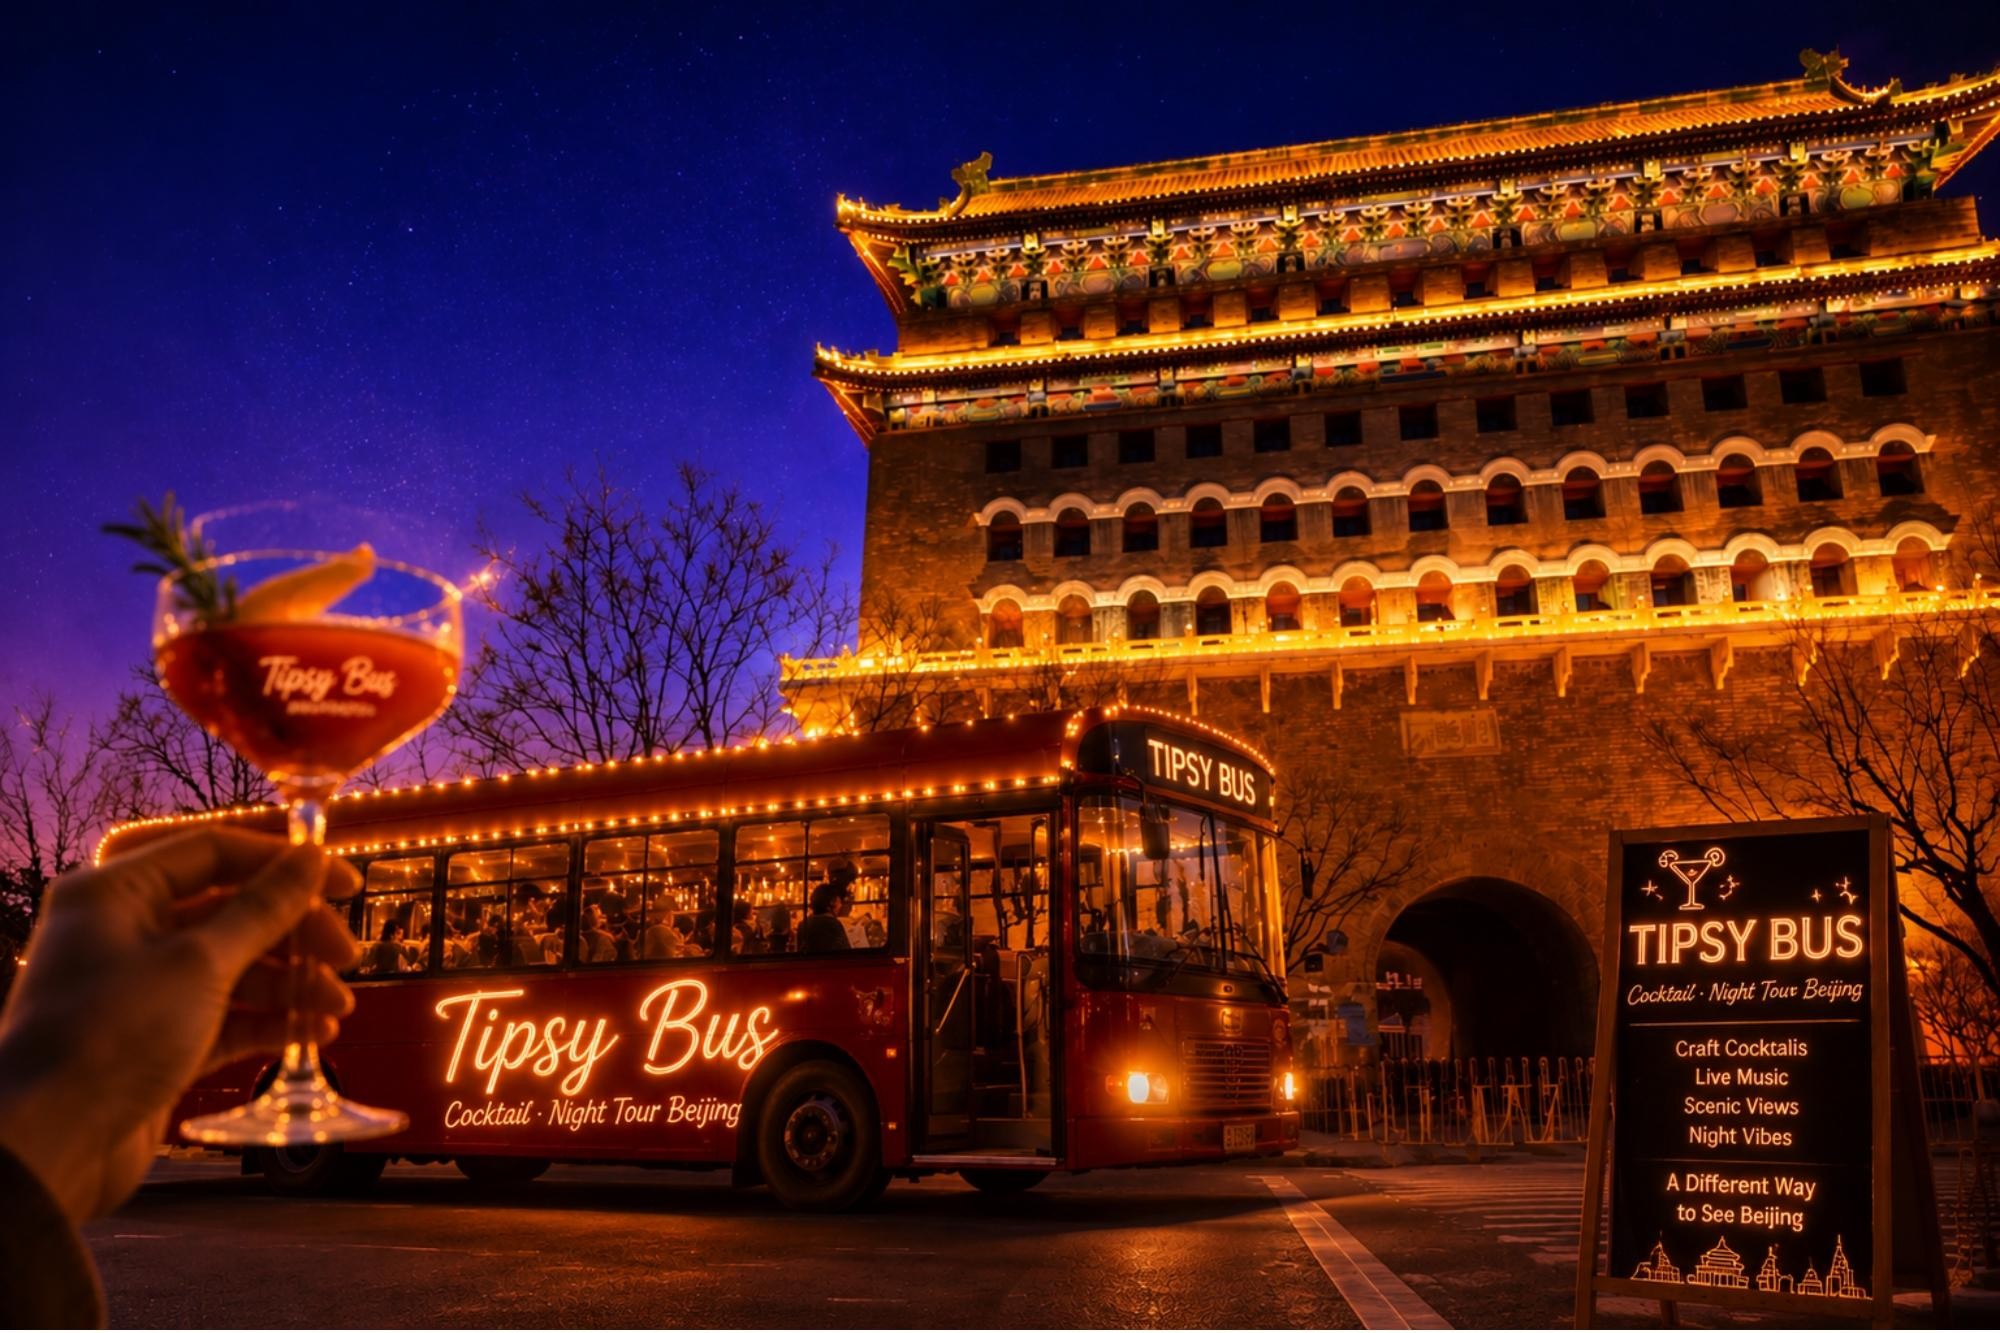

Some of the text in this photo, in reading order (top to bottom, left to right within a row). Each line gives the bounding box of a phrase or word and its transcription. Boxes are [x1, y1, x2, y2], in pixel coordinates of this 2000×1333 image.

[259, 655, 398, 701] Tipsy Bus
[1148, 739, 1256, 805] TIPSY BUS
[1629, 915, 1863, 965] TIPSY BUS
[1627, 983, 1697, 1006] Cocktail
[1708, 981, 1756, 1006] Night
[1761, 979, 1798, 1001] Tour
[1803, 978, 1863, 1003] Beijing
[435, 979, 779, 1095] Tipsy Bus
[1675, 1039, 1720, 1057] Craft
[1695, 1068, 1789, 1086] Live Music
[444, 1100, 534, 1129] Cocktail
[548, 1099, 608, 1132] Night
[613, 1096, 661, 1124] Tour
[667, 1095, 742, 1129] Beijing
[1684, 1096, 1799, 1116] Scenic Views
[1689, 1126, 1792, 1148] Night Vibes
[1666, 1172, 1816, 1202] A Different Way
[1677, 1203, 1804, 1232] to See Beijing
